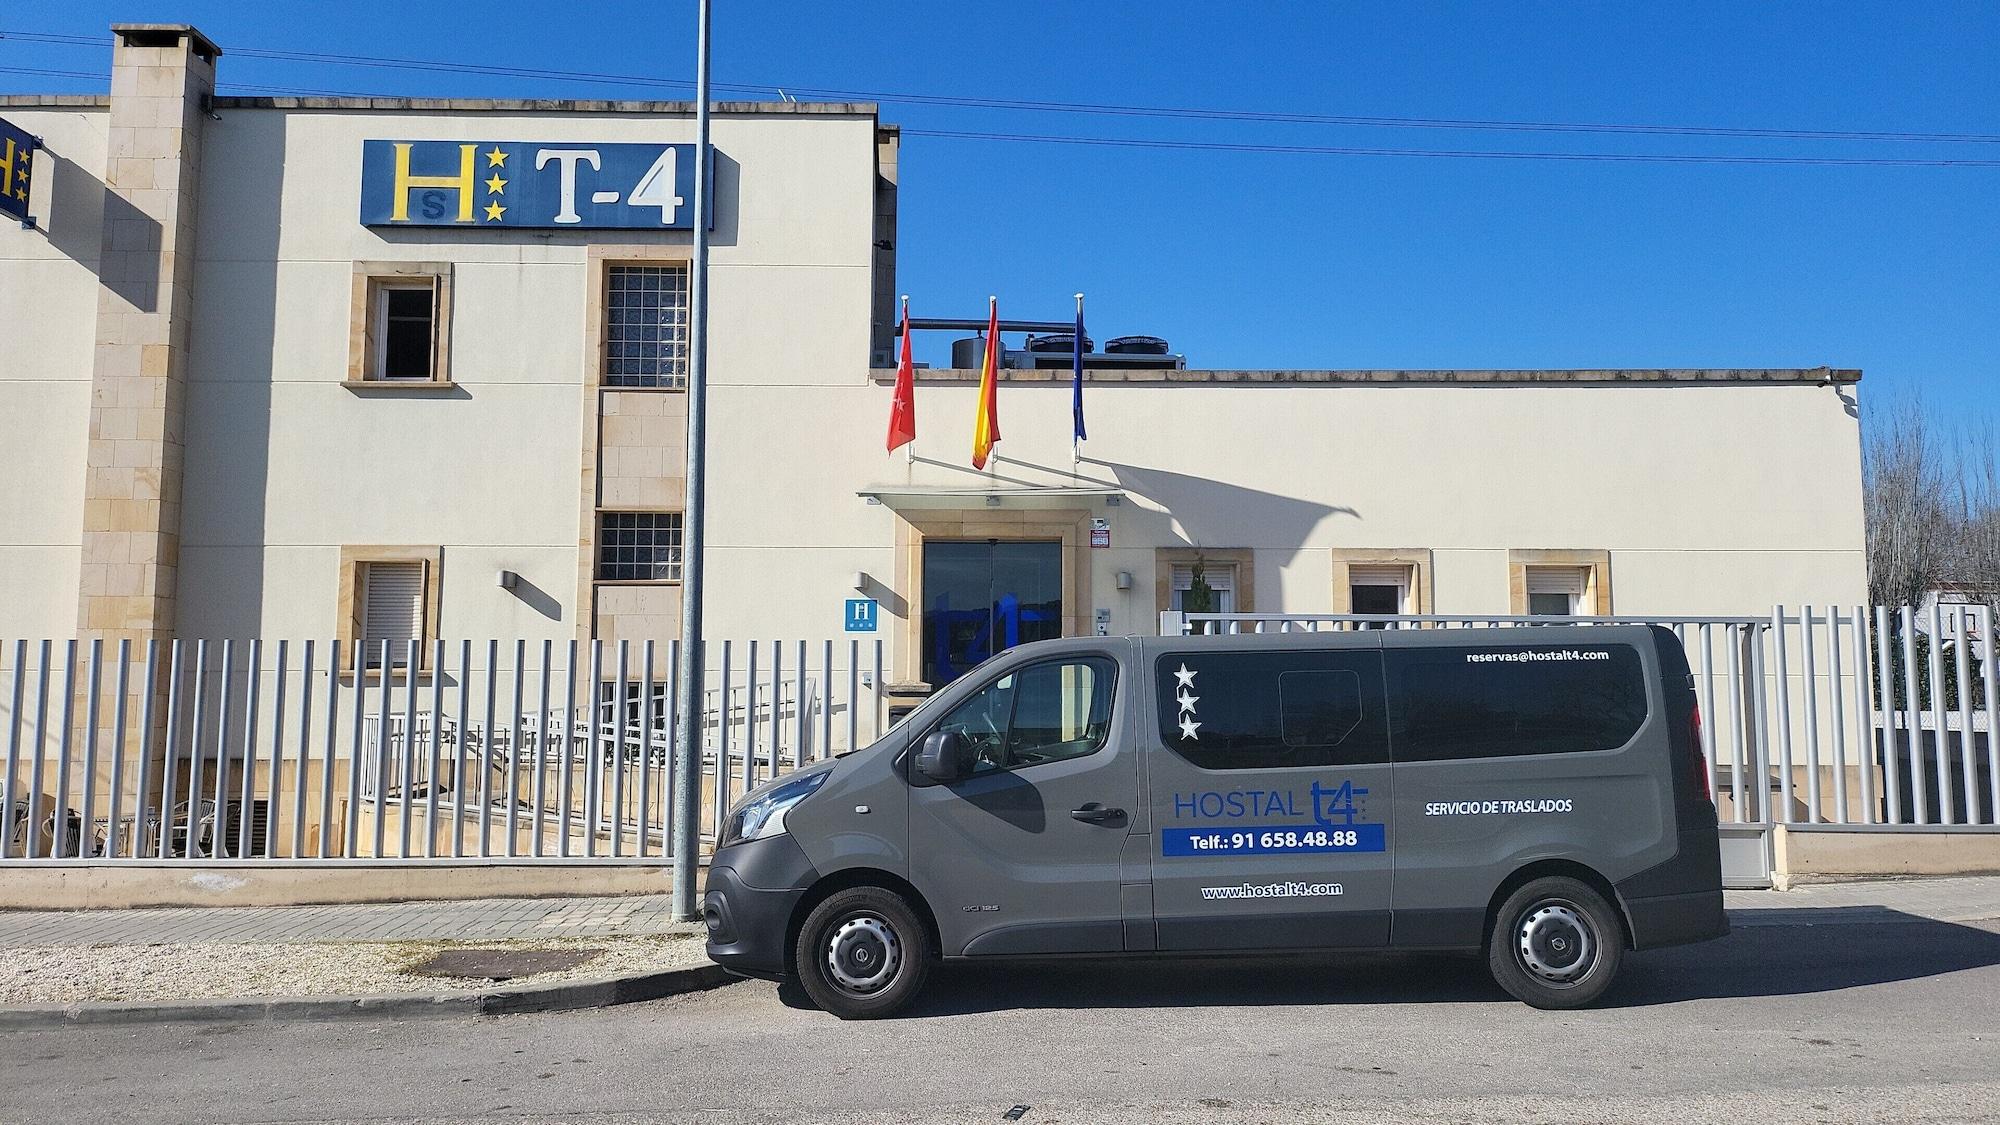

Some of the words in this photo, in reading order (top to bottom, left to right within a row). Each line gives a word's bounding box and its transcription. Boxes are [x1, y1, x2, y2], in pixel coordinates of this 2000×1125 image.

[535, 146, 684, 225] T-4
[1466, 650, 1610, 663] reservas@hostalt4.com
[1174, 790, 1305, 819] HOSTAL
[1310, 779, 1369, 826] t4
[1425, 801, 1481, 816] SERVICIO
[1482, 800, 1499, 814] DE
[1500, 799, 1573, 814] TRASLADOS
[1190, 834, 1229, 850] Telf.:
[1231, 833, 1255, 849] 91
[1260, 830, 1358, 848] 658.48.88
[1200, 881, 1344, 901] www.hostalt4.com
